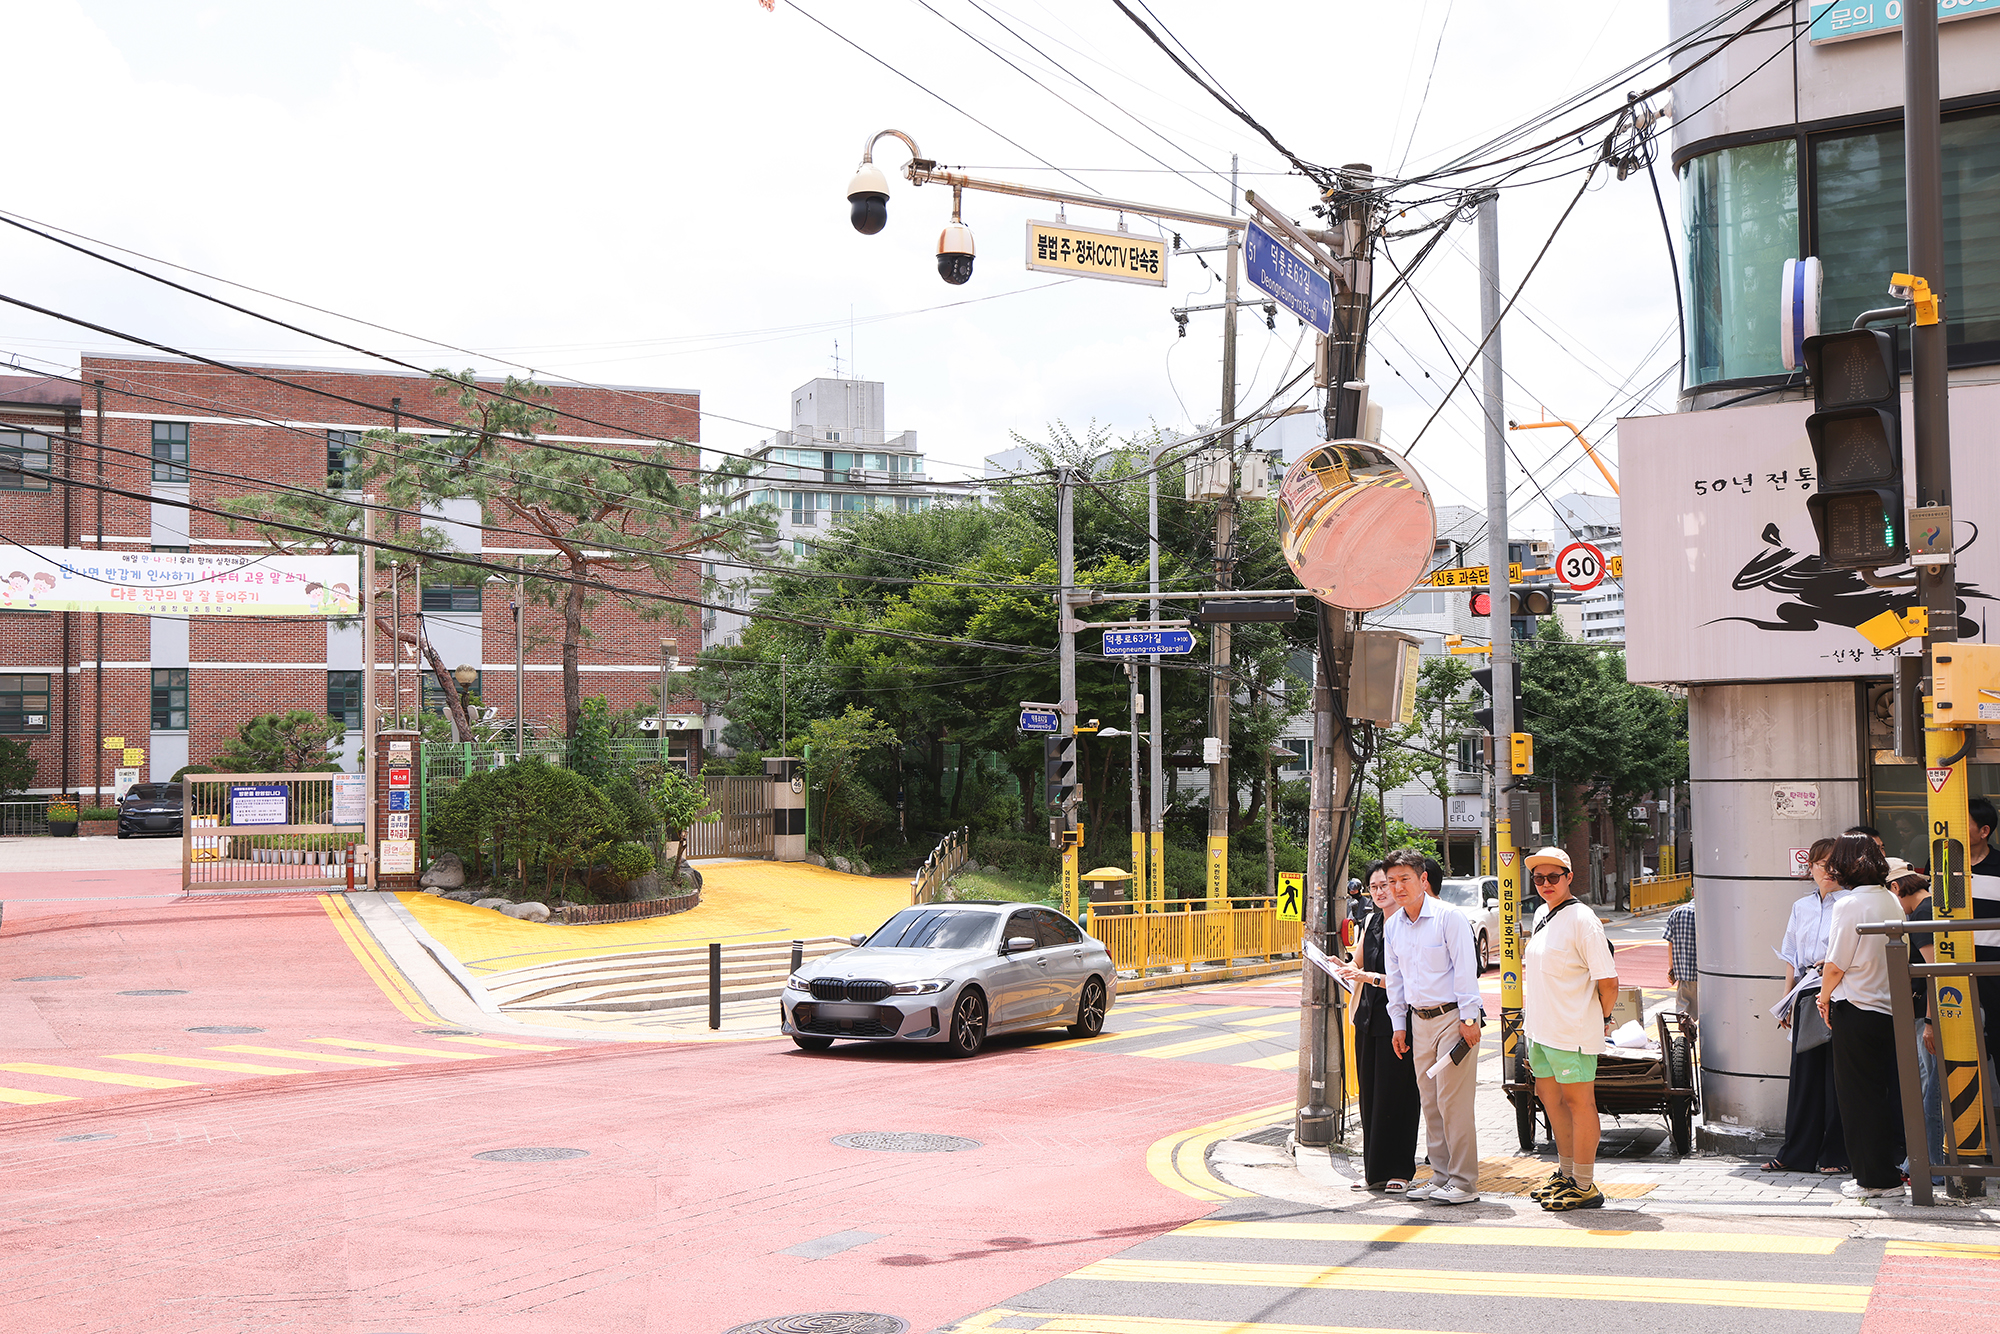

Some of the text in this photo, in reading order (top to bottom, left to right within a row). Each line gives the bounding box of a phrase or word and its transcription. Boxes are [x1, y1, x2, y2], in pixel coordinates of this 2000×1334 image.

[1831, 4, 1873, 31] 문의
[1037, 233, 1058, 261] 불법
[1129, 247, 1159, 274] 단속중
[1248, 241, 1256, 263] 51
[1270, 244, 1310, 296] 덕릉로63길
[1261, 268, 1317, 322] Deongneung-ro 63-gil
[1322, 298, 1329, 316] 47
[1694, 467, 1816, 496] 50년 전통
[122, 555, 138, 564] 매일
[180, 556, 194, 564] 우리
[197, 557, 213, 566] 함께
[1567, 556, 1595, 578] 30
[60, 563, 306, 585] 만나면 반갑게 인사하기 나부터 고운 말 쓰기
[1436, 571, 1454, 586] 신호
[1459, 570, 1489, 584] 과속단
[110, 587, 259, 603] 다른 친구의 말 잘 들어주기
[1105, 633, 1162, 645] 덕릉로63가길
[1105, 645, 1184, 654] Deongneung-ro 63ga-gil
[1450, 814, 1475, 822] EFLO
[390, 829, 408, 838] 주차금지
[383, 846, 399, 854] 금연
[1940, 1008, 1962, 1019] 도봉구
